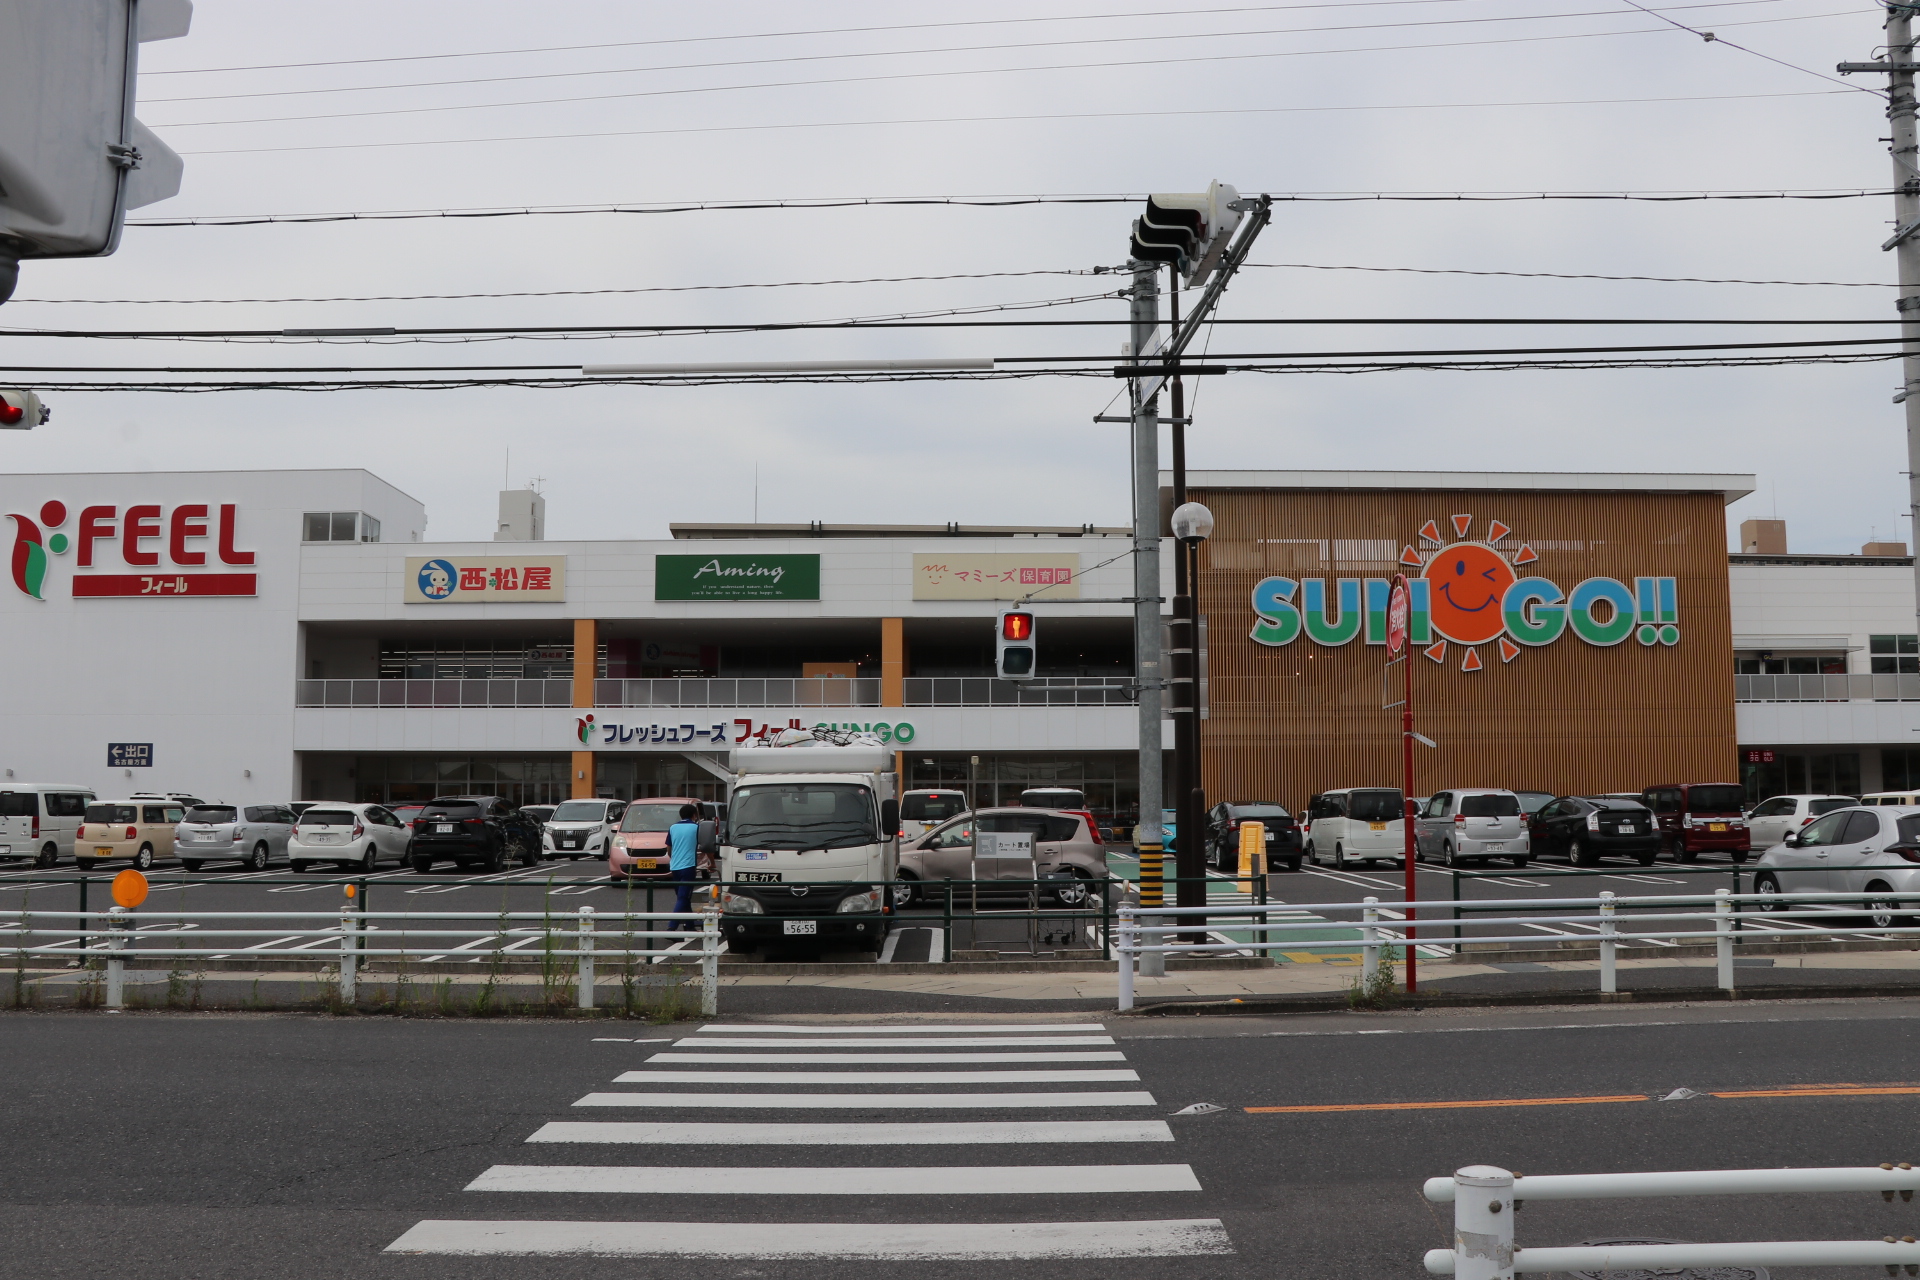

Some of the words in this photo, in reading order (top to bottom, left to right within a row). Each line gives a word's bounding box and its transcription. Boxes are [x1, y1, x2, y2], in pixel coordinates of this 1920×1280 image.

[76, 503, 256, 567] FEEL
[459, 566, 552, 591] 西松屋
[692, 559, 786, 584] Aming
[954, 567, 1072, 584] マミーズ保育園
[141, 577, 188, 594] フィール
[1250, 575, 1432, 646] SUN
[1501, 576, 1680, 646] GO!!
[602, 722, 727, 744] フレッシュフーズ
[125, 745, 149, 758] 出口
[114, 758, 147, 766] 名古屋方面
[998, 841, 1030, 849] カート置場
[737, 873, 779, 883] 高圧ガス
